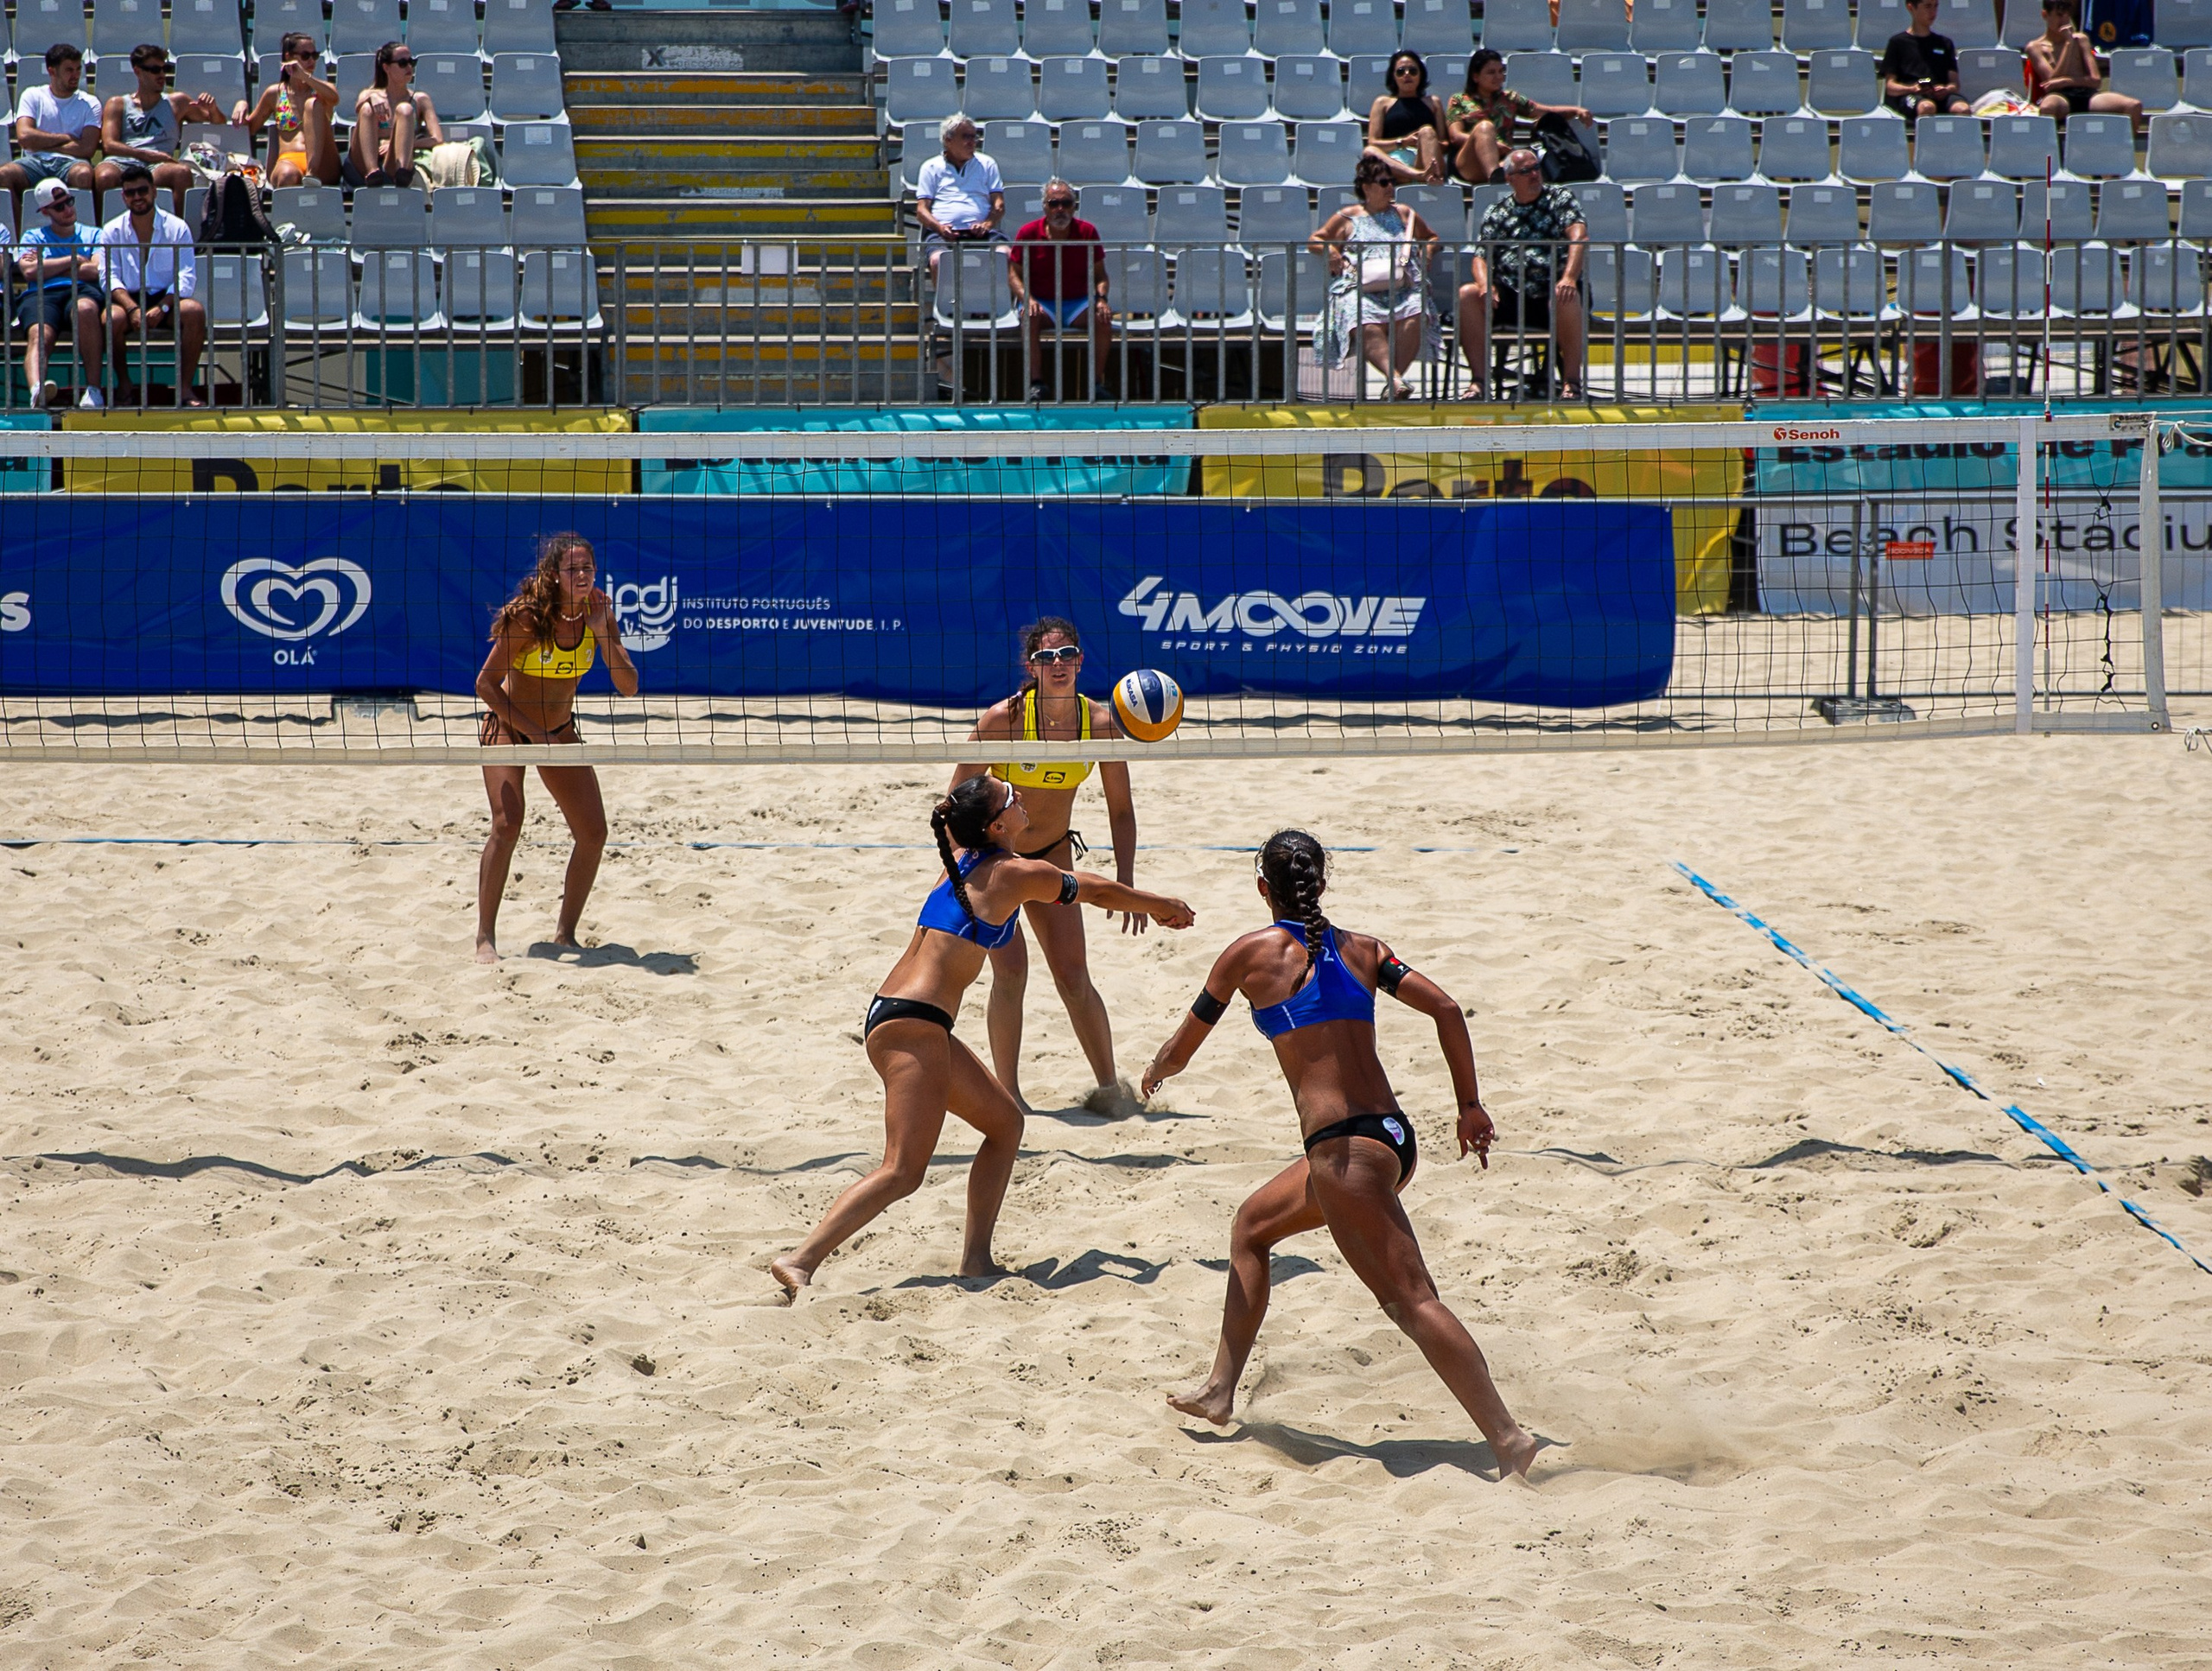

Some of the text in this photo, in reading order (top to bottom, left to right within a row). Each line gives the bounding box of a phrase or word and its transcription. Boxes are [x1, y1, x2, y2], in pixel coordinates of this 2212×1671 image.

[1789, 429, 1840, 441] Senoh
[682, 595, 830, 610] INSTITUTO PORTUGUÊS
[683, 617, 703, 630] DO
[706, 617, 779, 630] DESPORTO
[782, 618, 790, 630] E
[1160, 640, 1230, 651] SPORT
[1266, 643, 1342, 655] PHYSIO
[1353, 644, 1408, 654] ZONE
[1126, 678, 1139, 708] MIKASA
